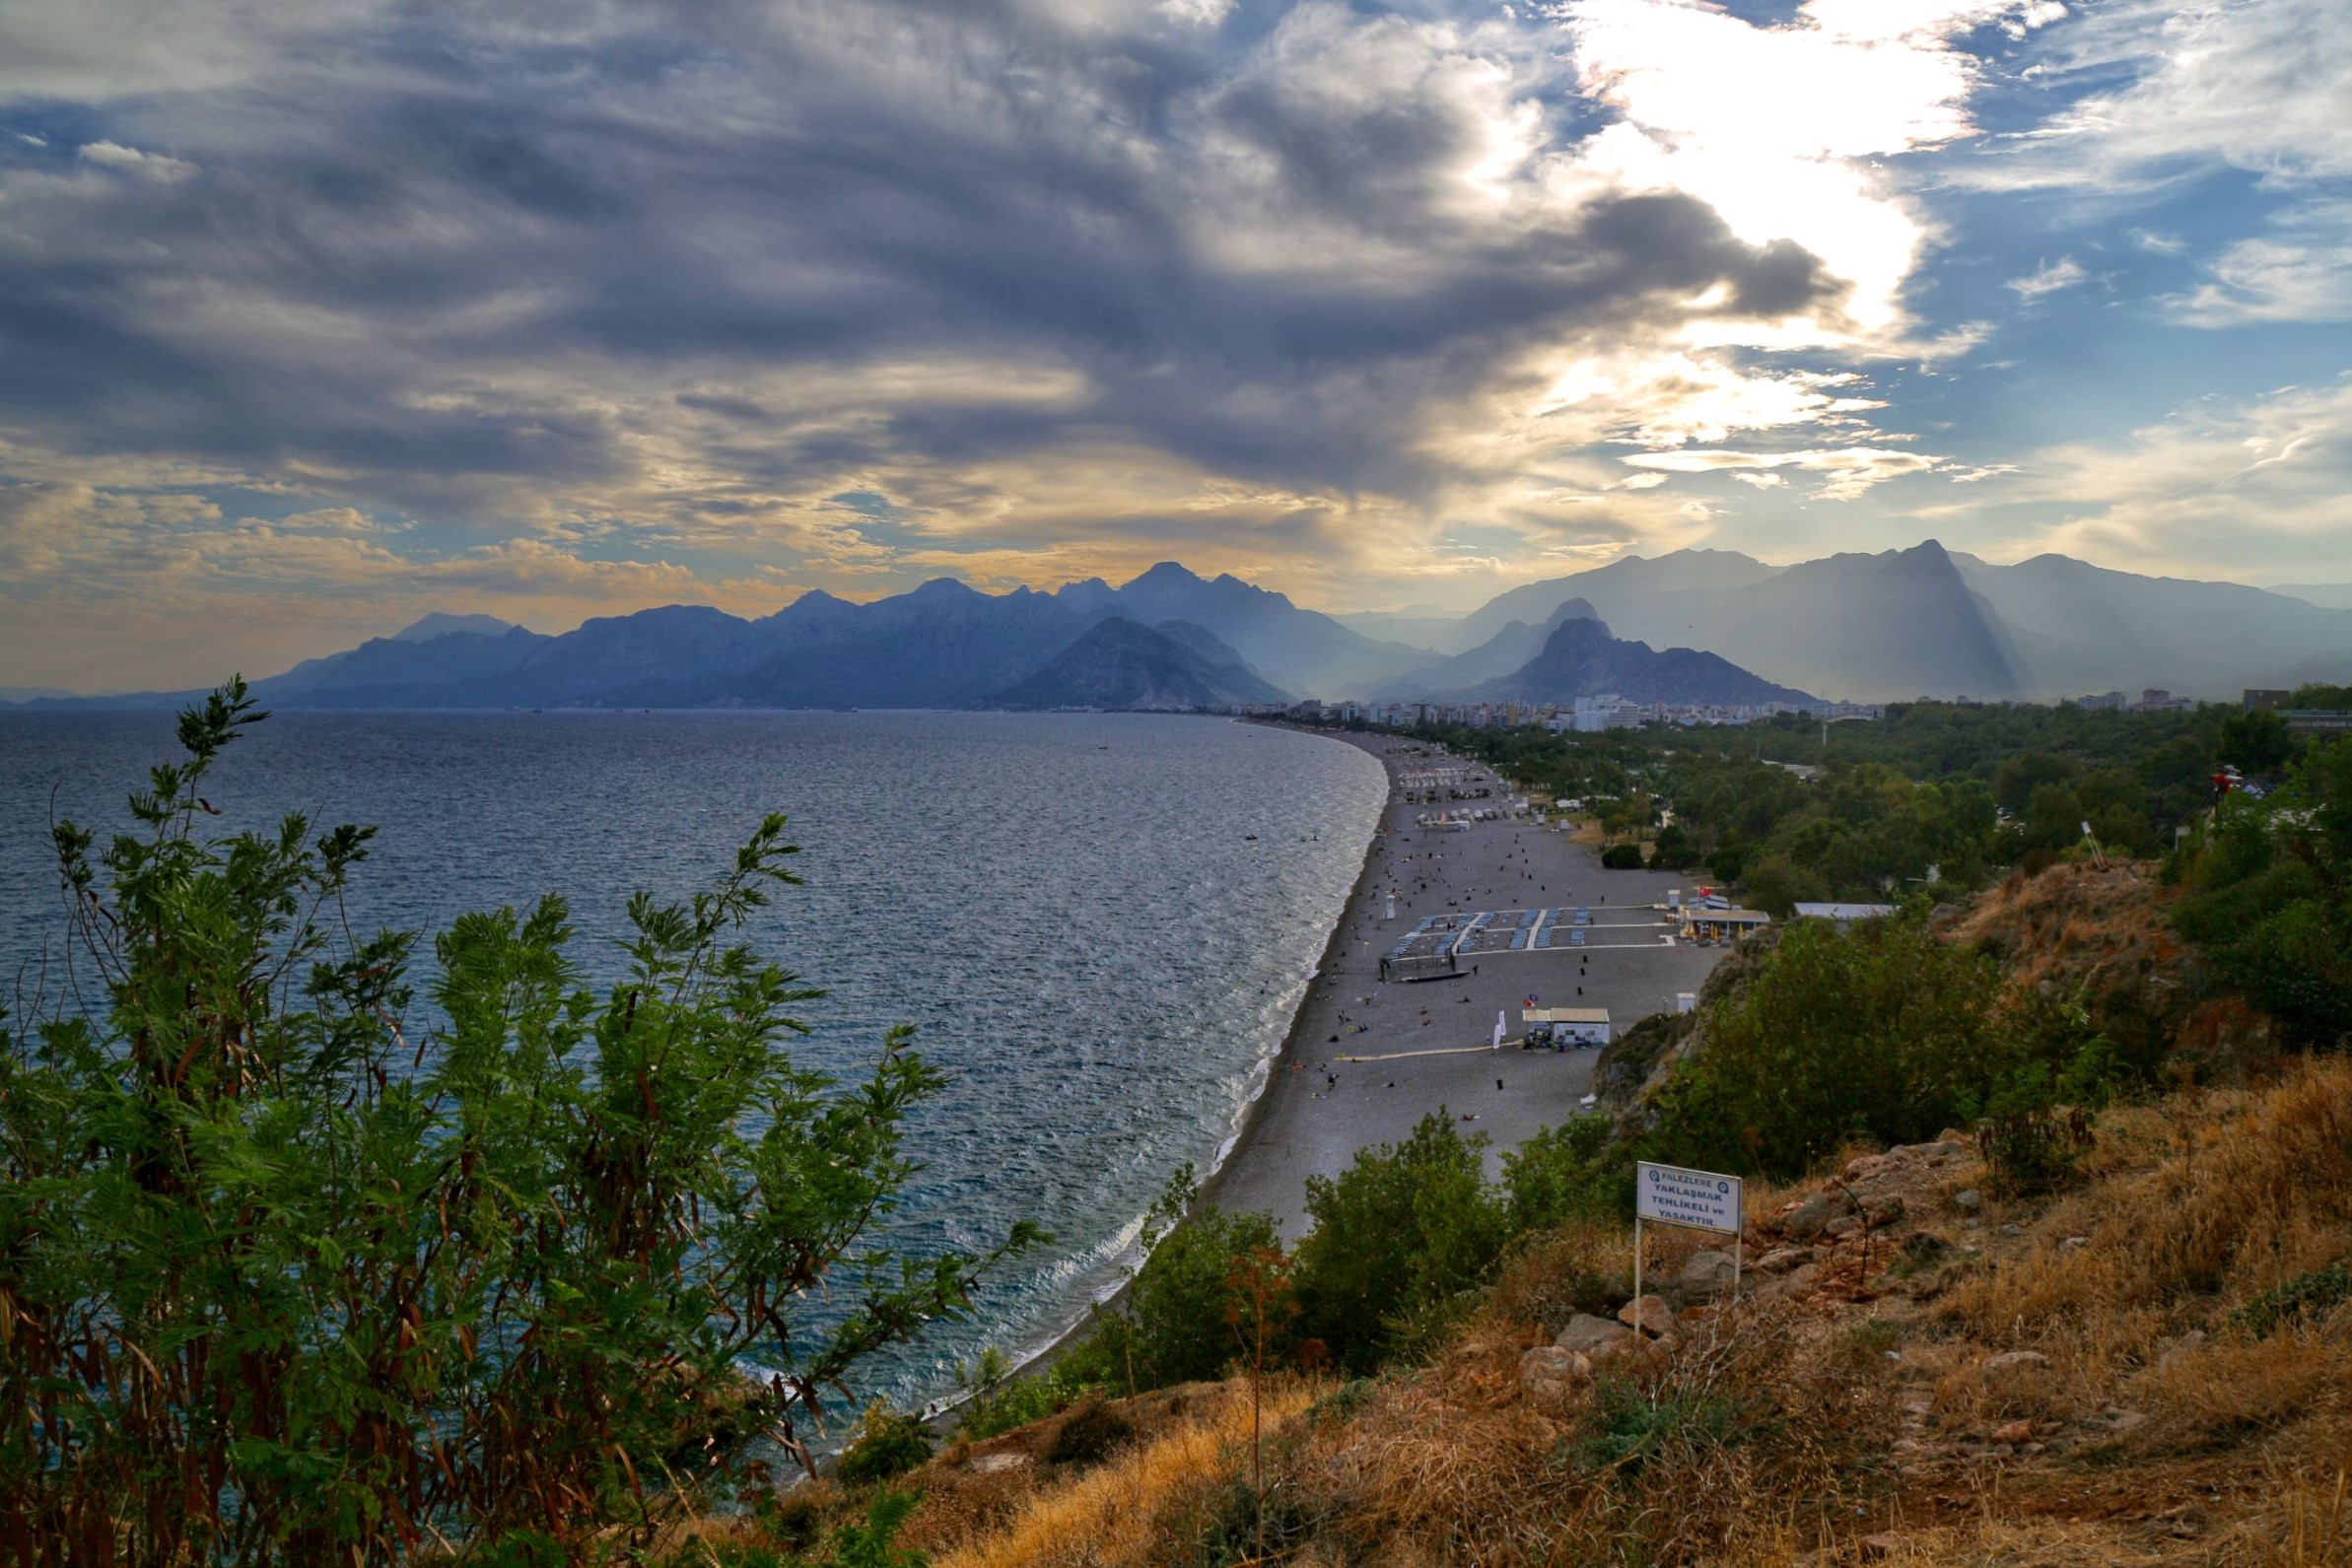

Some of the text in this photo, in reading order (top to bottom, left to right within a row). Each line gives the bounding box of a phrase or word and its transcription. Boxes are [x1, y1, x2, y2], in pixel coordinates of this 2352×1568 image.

[1662, 1173, 1712, 1188] FALEZLERE
[1654, 1184, 1723, 1201] YAKLAŞMAK
[1651, 1195, 1708, 1212] TEHLİKELİ
